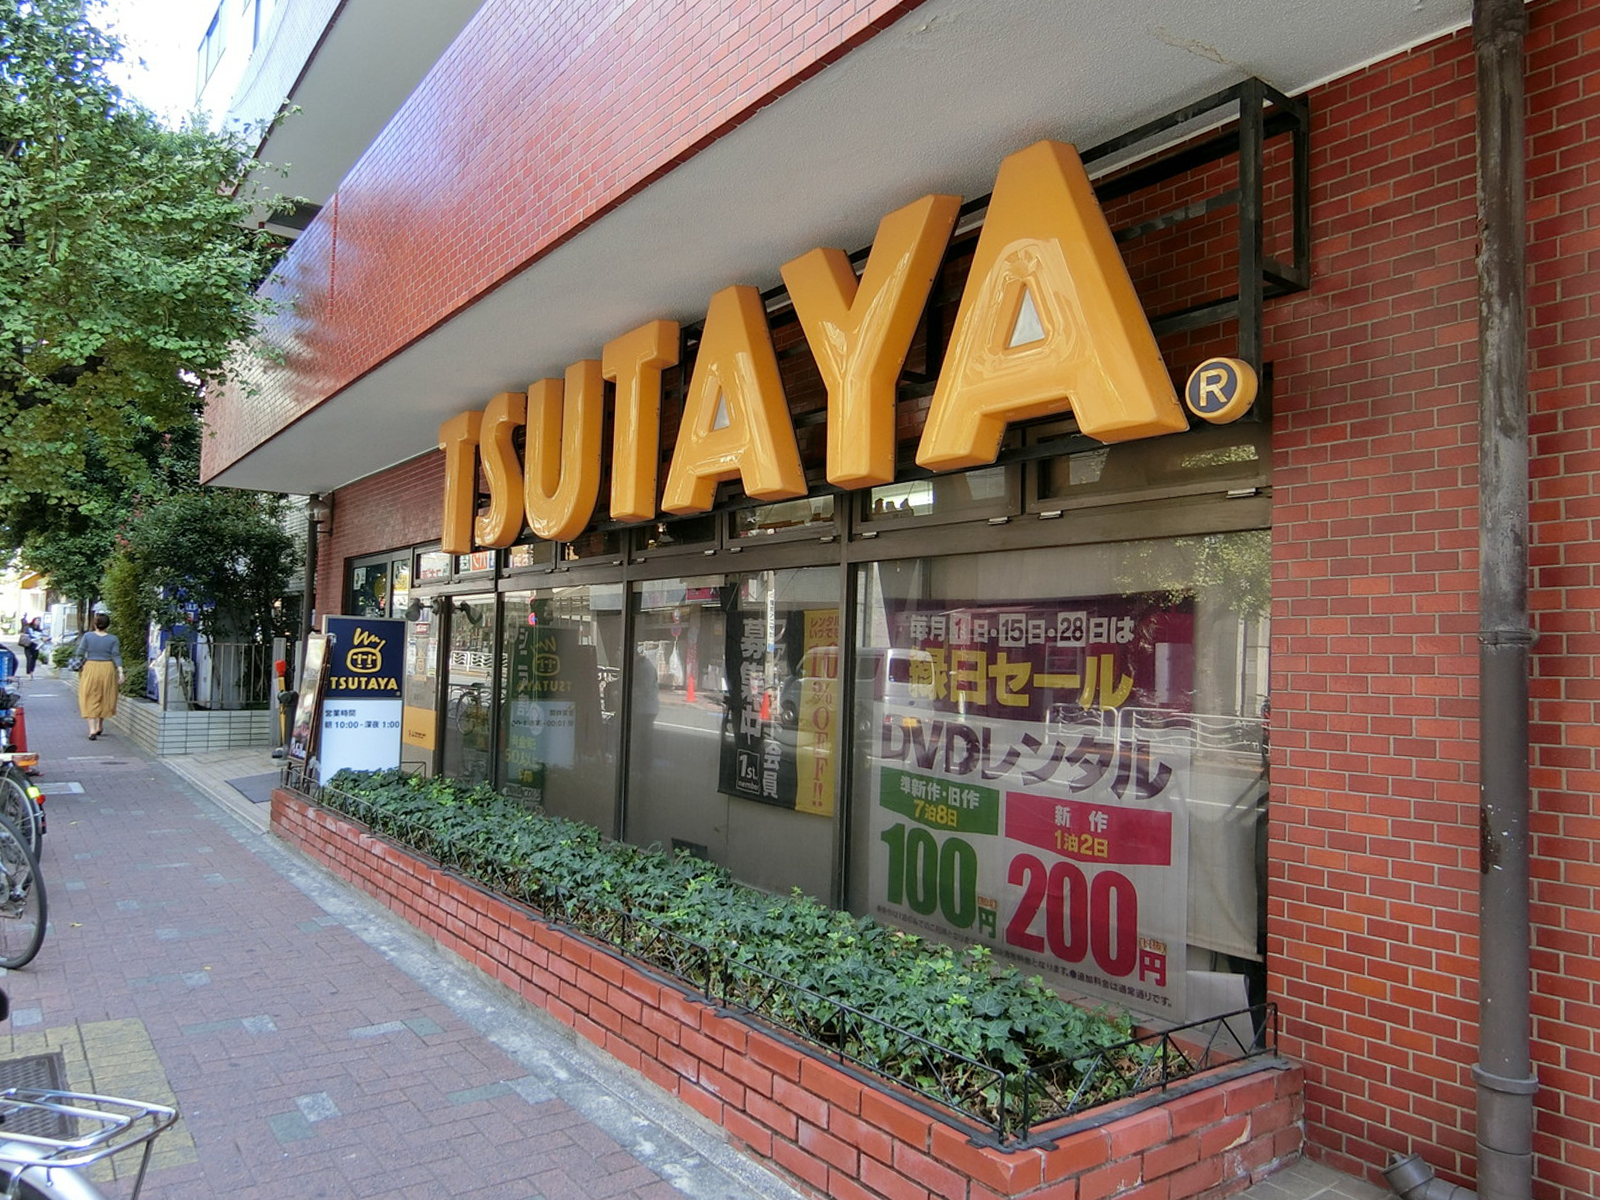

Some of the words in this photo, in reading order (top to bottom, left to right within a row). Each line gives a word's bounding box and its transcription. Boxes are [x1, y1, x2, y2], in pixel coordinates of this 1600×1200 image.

[438, 139, 1190, 555] TSUTAYA
[330, 676, 398, 691] TSUTAYA
[382, 720, 400, 729] 1:00
[880, 717, 1172, 800] DVDレンタル
[913, 799, 958, 827] 7泊8日
[1054, 830, 1109, 859] 1泊2日
